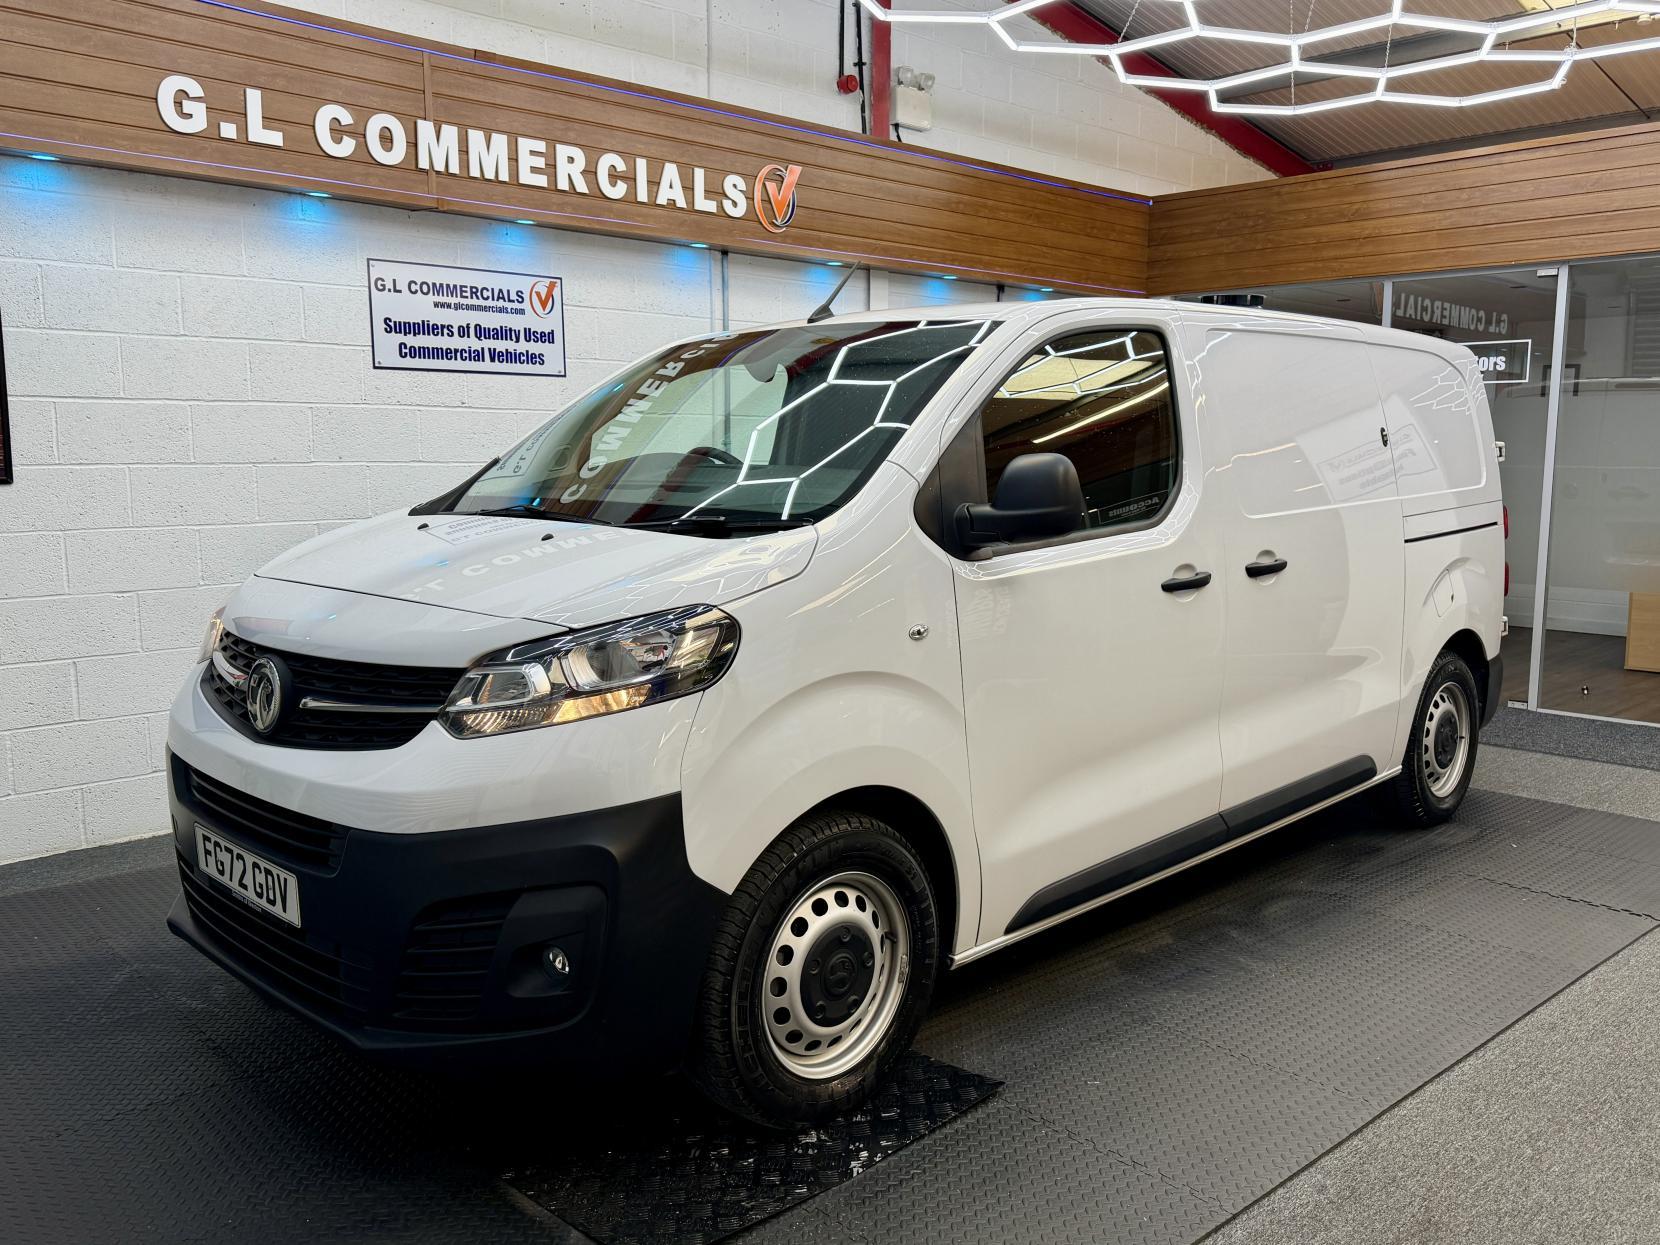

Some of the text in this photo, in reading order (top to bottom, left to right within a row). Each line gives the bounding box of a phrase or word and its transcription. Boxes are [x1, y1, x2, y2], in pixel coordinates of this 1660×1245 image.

[157, 75, 747, 218] G.L COMMERCIALS
[374, 277, 525, 304] G.L COMMERCIALS
[433, 300, 526, 316] www.glcommercials.com
[383, 317, 555, 344] Suppliers of Quality Used
[398, 342, 545, 365] Commercial Vehicles
[1476, 355, 1506, 371] ors
[202, 833, 249, 892] FG72
[251, 861, 288, 914] GDV
